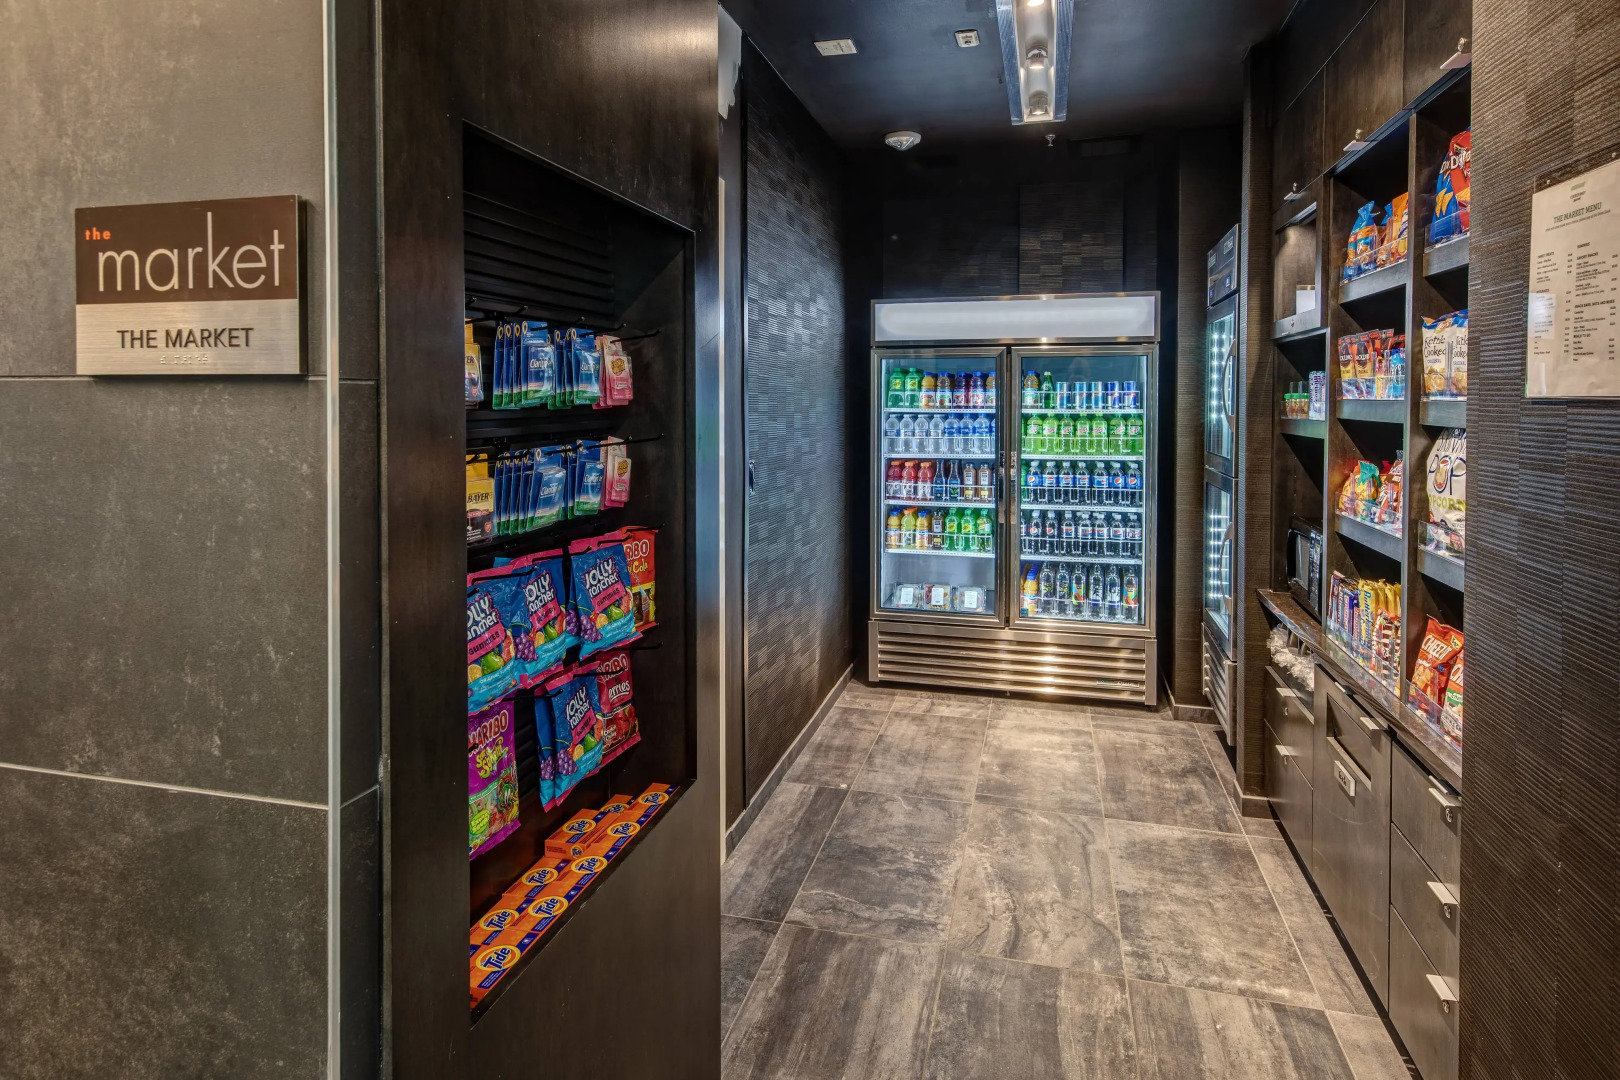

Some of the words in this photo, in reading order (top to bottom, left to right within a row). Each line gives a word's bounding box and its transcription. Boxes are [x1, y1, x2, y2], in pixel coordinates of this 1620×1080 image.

[1554, 215, 1563, 224] THE
[1564, 208, 1585, 221] MARKET
[1585, 202, 1602, 214] MENU
[85, 227, 111, 240] the
[98, 212, 285, 292] market
[116, 329, 158, 349] THE
[165, 327, 254, 348] MARKET
[467, 492, 489, 504] BAYER
[585, 558, 612, 589] JOLLY
[588, 572, 618, 598] rancher
[566, 686, 586, 720] JOLLY
[570, 699, 590, 729] rancher
[645, 792, 661, 804] Tide
[569, 819, 588, 833] Tide
[614, 822, 632, 835] Tide
[578, 857, 599, 872] Tide
[528, 868, 550, 885] Tide
[535, 897, 559, 916] Tide
[486, 910, 511, 930] Tide
[484, 947, 511, 970] Tide
